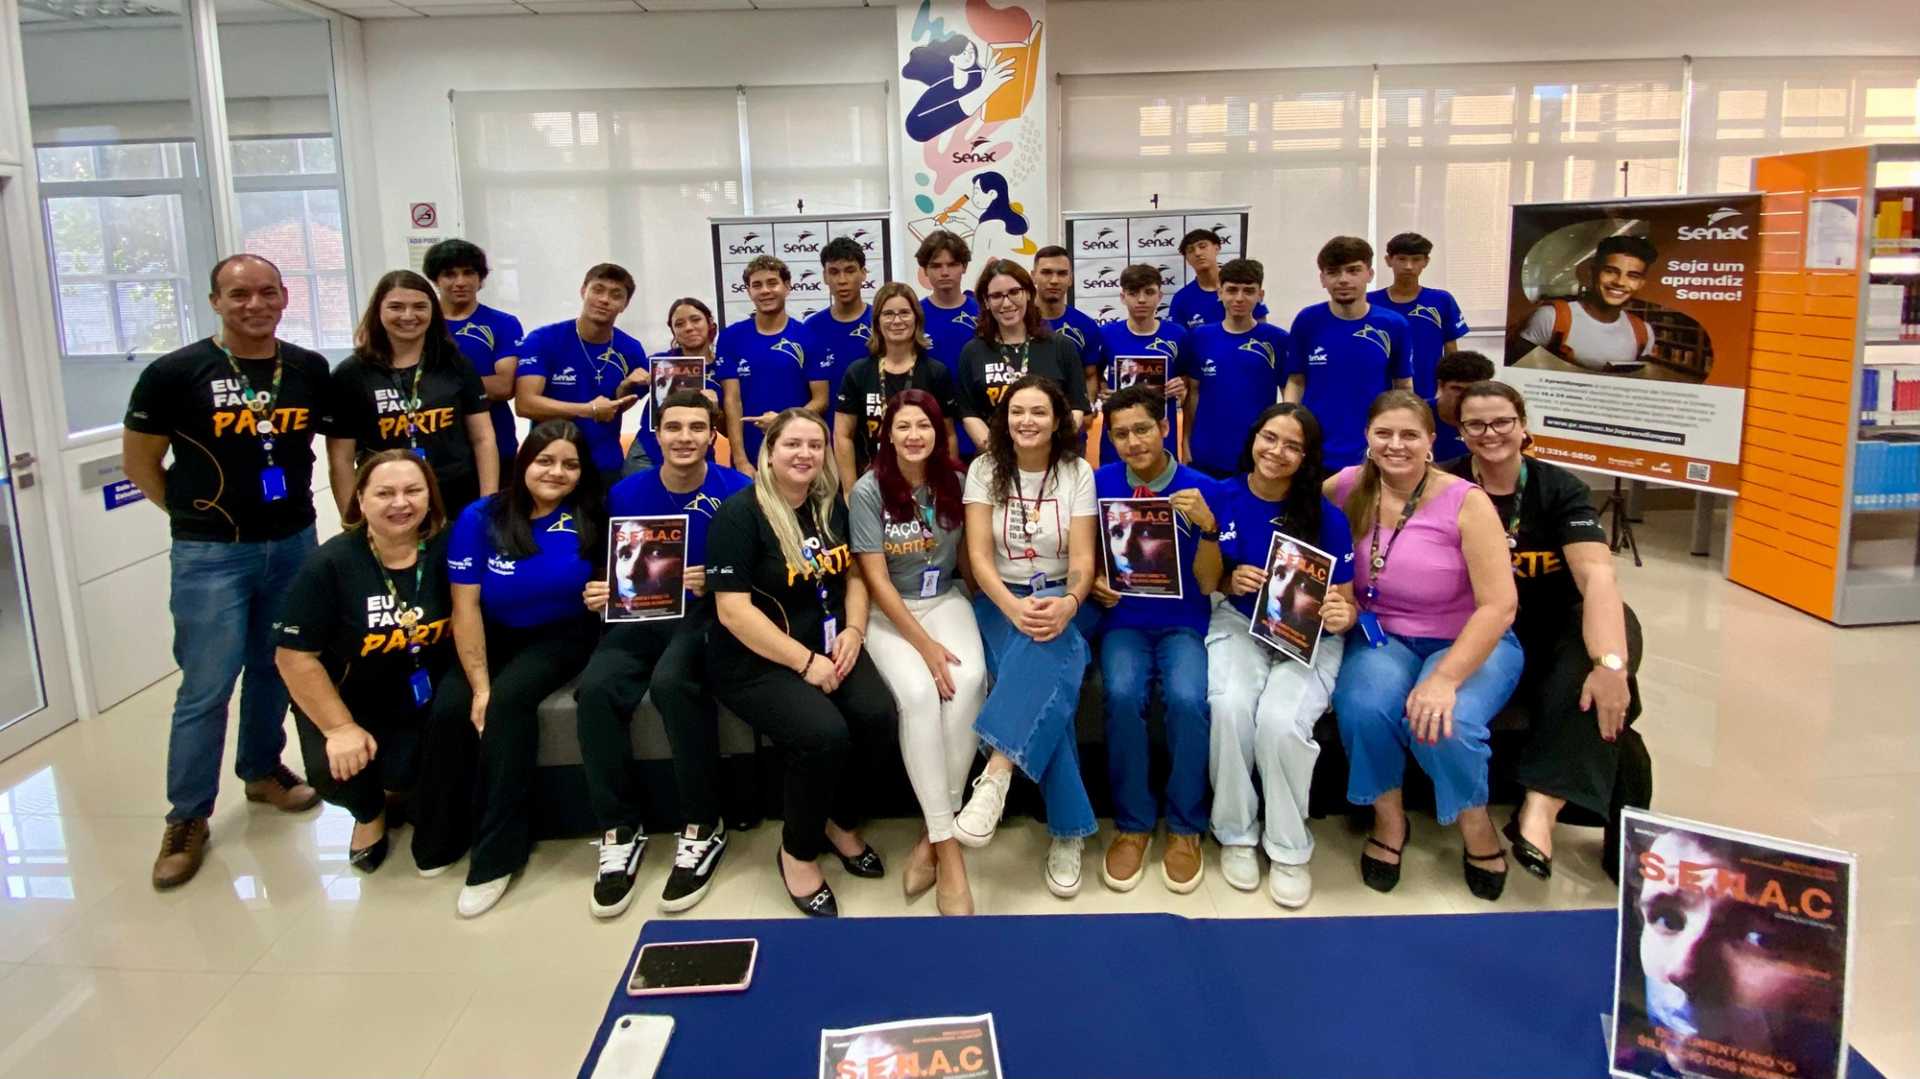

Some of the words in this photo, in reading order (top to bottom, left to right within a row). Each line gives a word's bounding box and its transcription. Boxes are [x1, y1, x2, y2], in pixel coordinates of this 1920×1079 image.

[952, 151, 997, 163] Senac
[1677, 225, 1750, 241] Senac
[783, 242, 819, 253] Senac
[1082, 240, 1119, 249] Senac
[1137, 237, 1175, 248] Senac
[729, 244, 765, 255] Senac
[1667, 260, 1708, 274] Seja
[1713, 262, 1744, 273] um
[1083, 278, 1120, 289] Senac
[1661, 274, 1743, 287] aprendiz
[1675, 288, 1742, 301] Senac!
[985, 363, 1004, 374] EU
[211, 378, 240, 393] EU
[374, 388, 399, 401] EU
[884, 520, 921, 539] FAÇO
[367, 595, 395, 611] EU
[360, 617, 449, 657] PART
